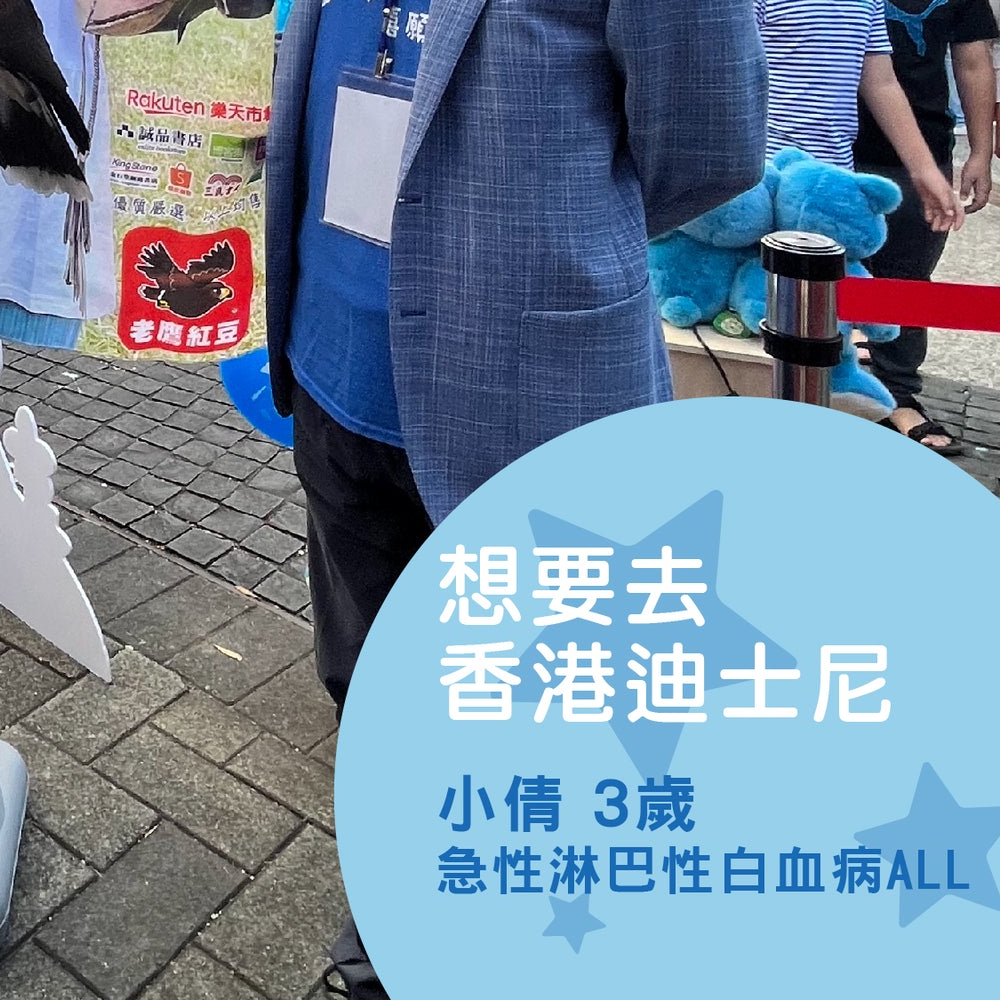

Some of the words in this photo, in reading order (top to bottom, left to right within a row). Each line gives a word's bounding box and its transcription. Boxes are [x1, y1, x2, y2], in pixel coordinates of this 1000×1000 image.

[128, 90, 205, 116] Rakuten
[138, 126, 202, 148] 誠品書店
[129, 318, 240, 348] 老鷹紅豆
